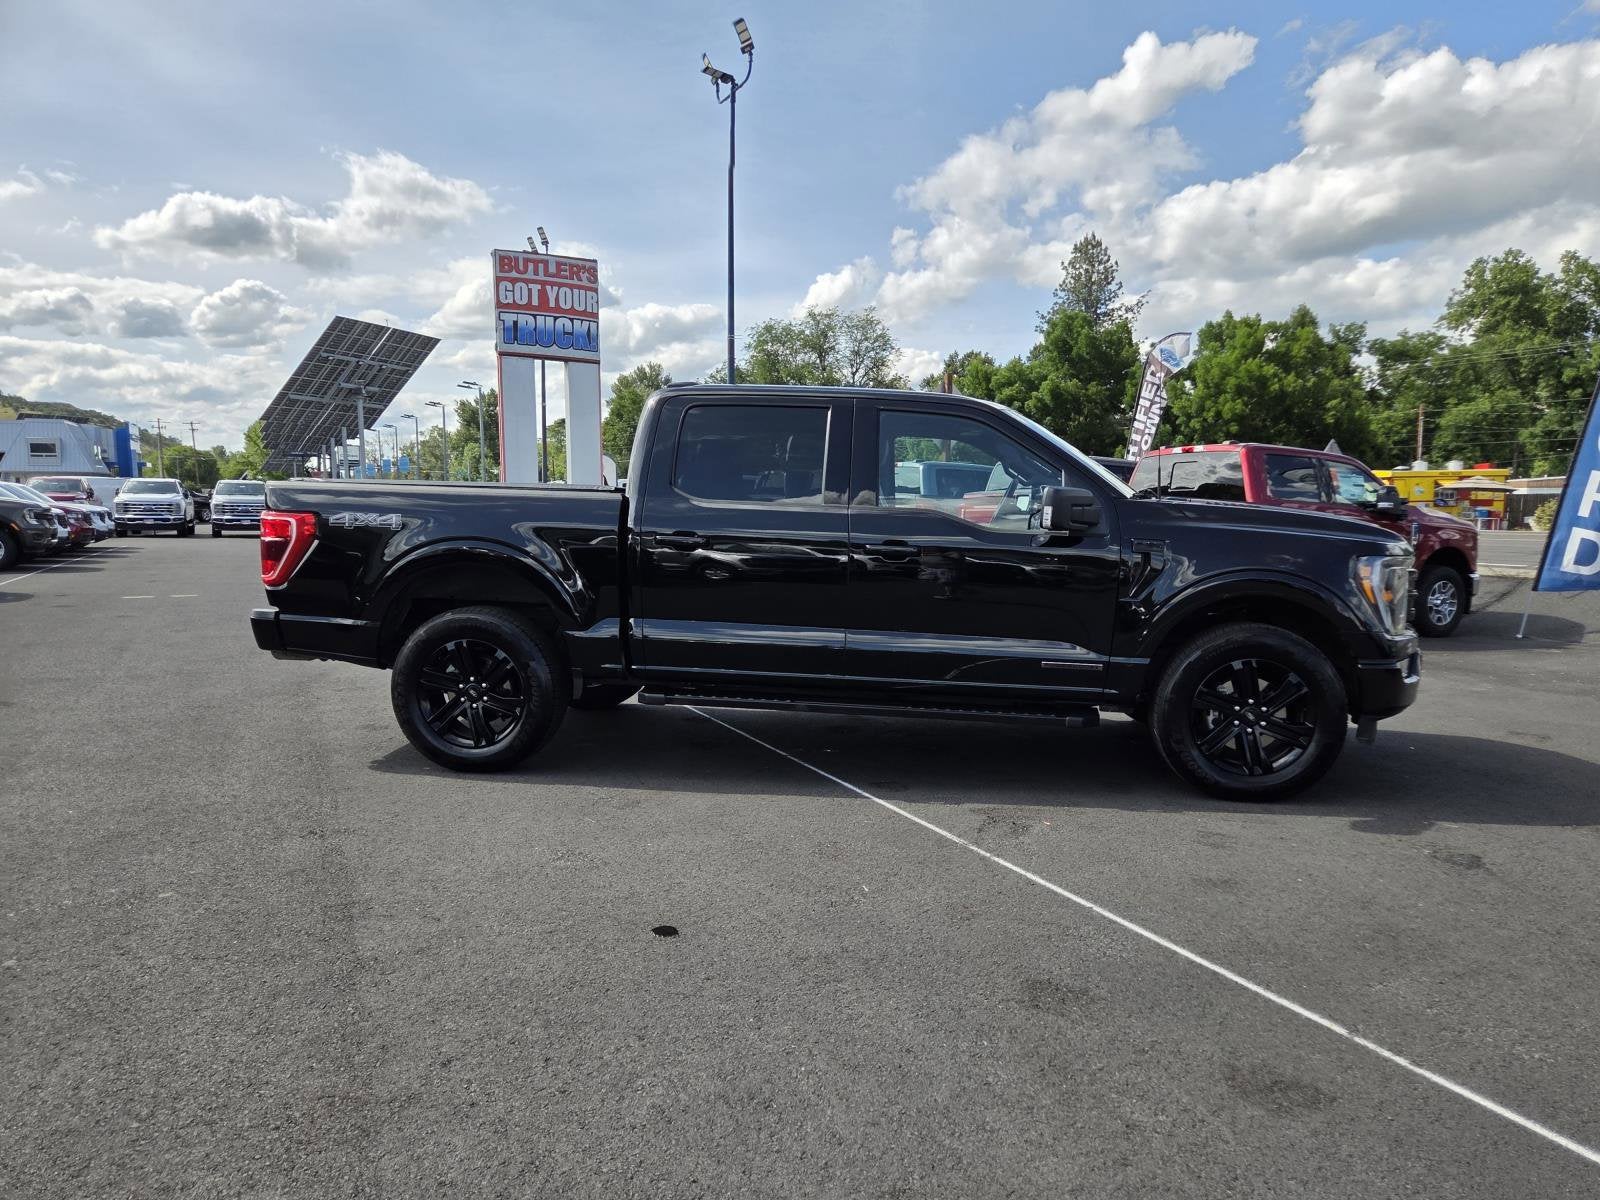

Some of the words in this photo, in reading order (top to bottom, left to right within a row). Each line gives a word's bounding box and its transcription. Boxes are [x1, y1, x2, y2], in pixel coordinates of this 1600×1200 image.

[498, 255, 598, 284] BUTLER'S
[498, 281, 541, 306] GOT
[546, 285, 598, 313] YOUR
[498, 311, 599, 352] TRUCK!
